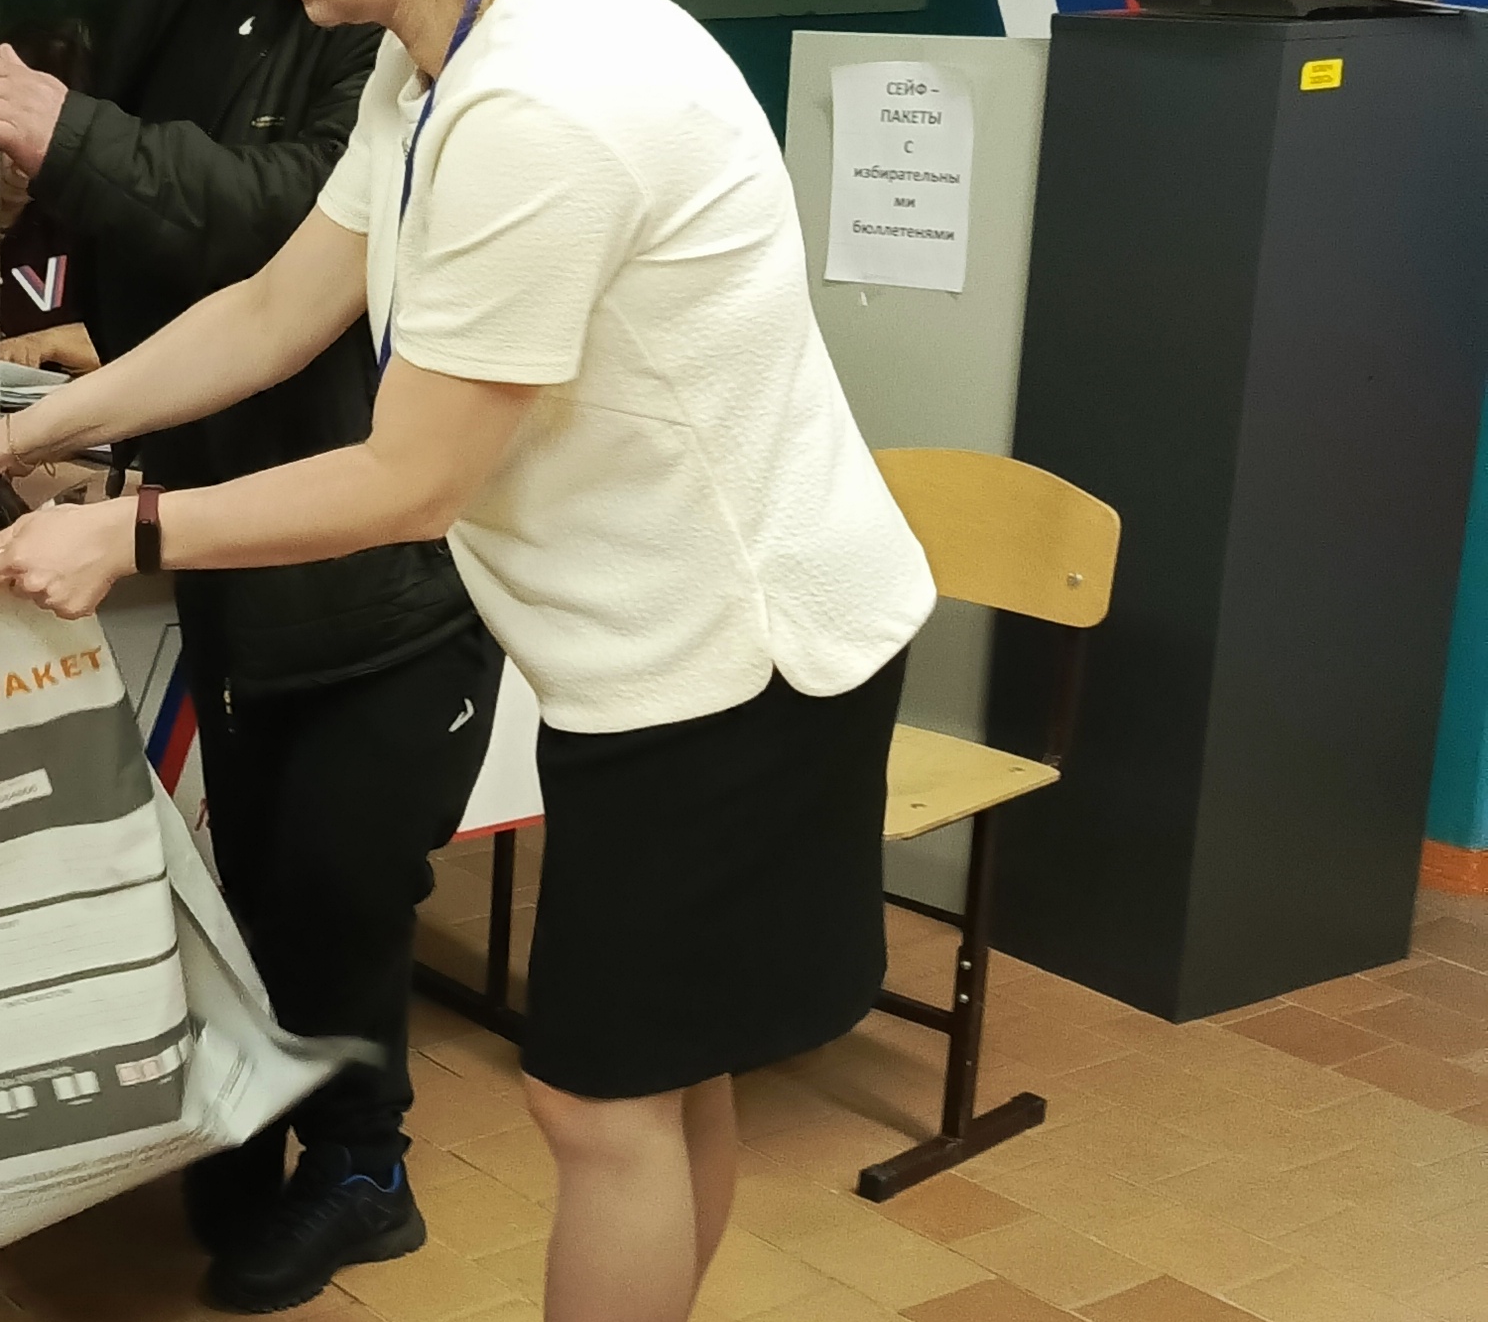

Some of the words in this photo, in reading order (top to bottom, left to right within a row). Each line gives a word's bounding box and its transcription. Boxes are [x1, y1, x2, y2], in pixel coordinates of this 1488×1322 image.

[886, 79, 927, 96] СЕЙФ
[880, 108, 942, 126] ПАКЕТЫ
[853, 165, 960, 185] избирательны
[893, 197, 916, 209] ми
[852, 220, 955, 242] бюллетенями
